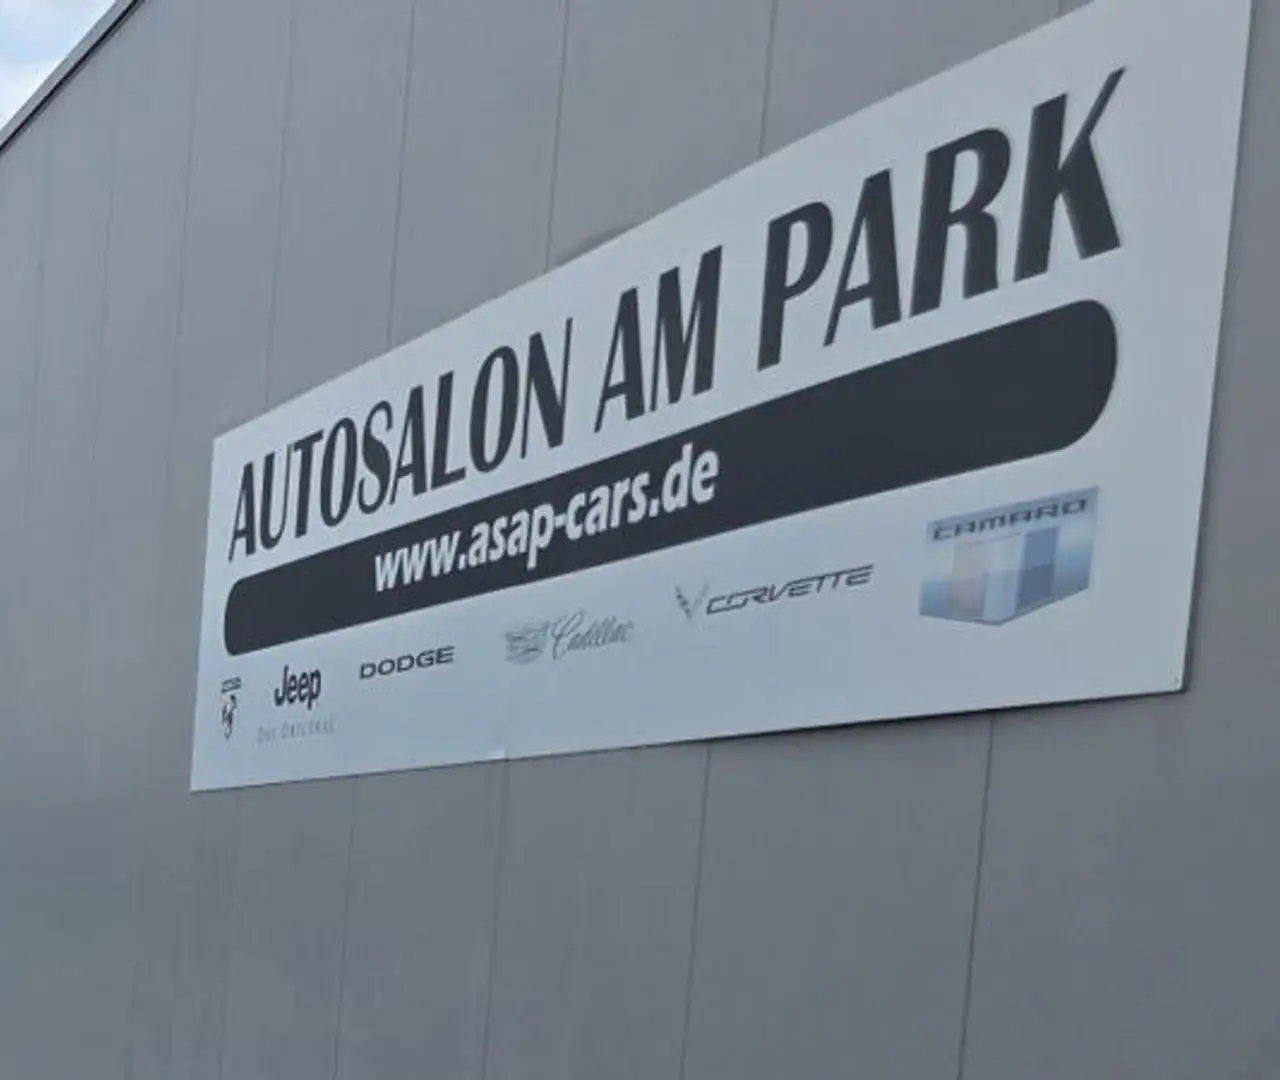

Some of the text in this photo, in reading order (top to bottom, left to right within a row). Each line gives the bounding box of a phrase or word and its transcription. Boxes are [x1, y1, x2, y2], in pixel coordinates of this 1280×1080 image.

[228, 66, 1127, 563] AUTOSALON AM PARK
[374, 443, 719, 592] www.asap-cars.de
[932, 499, 1088, 541] CAMARO
[705, 564, 874, 615] CORVETTE
[552, 610, 635, 661] Cadillac
[274, 664, 322, 711] Jeep
[359, 646, 455, 680] DODGE
